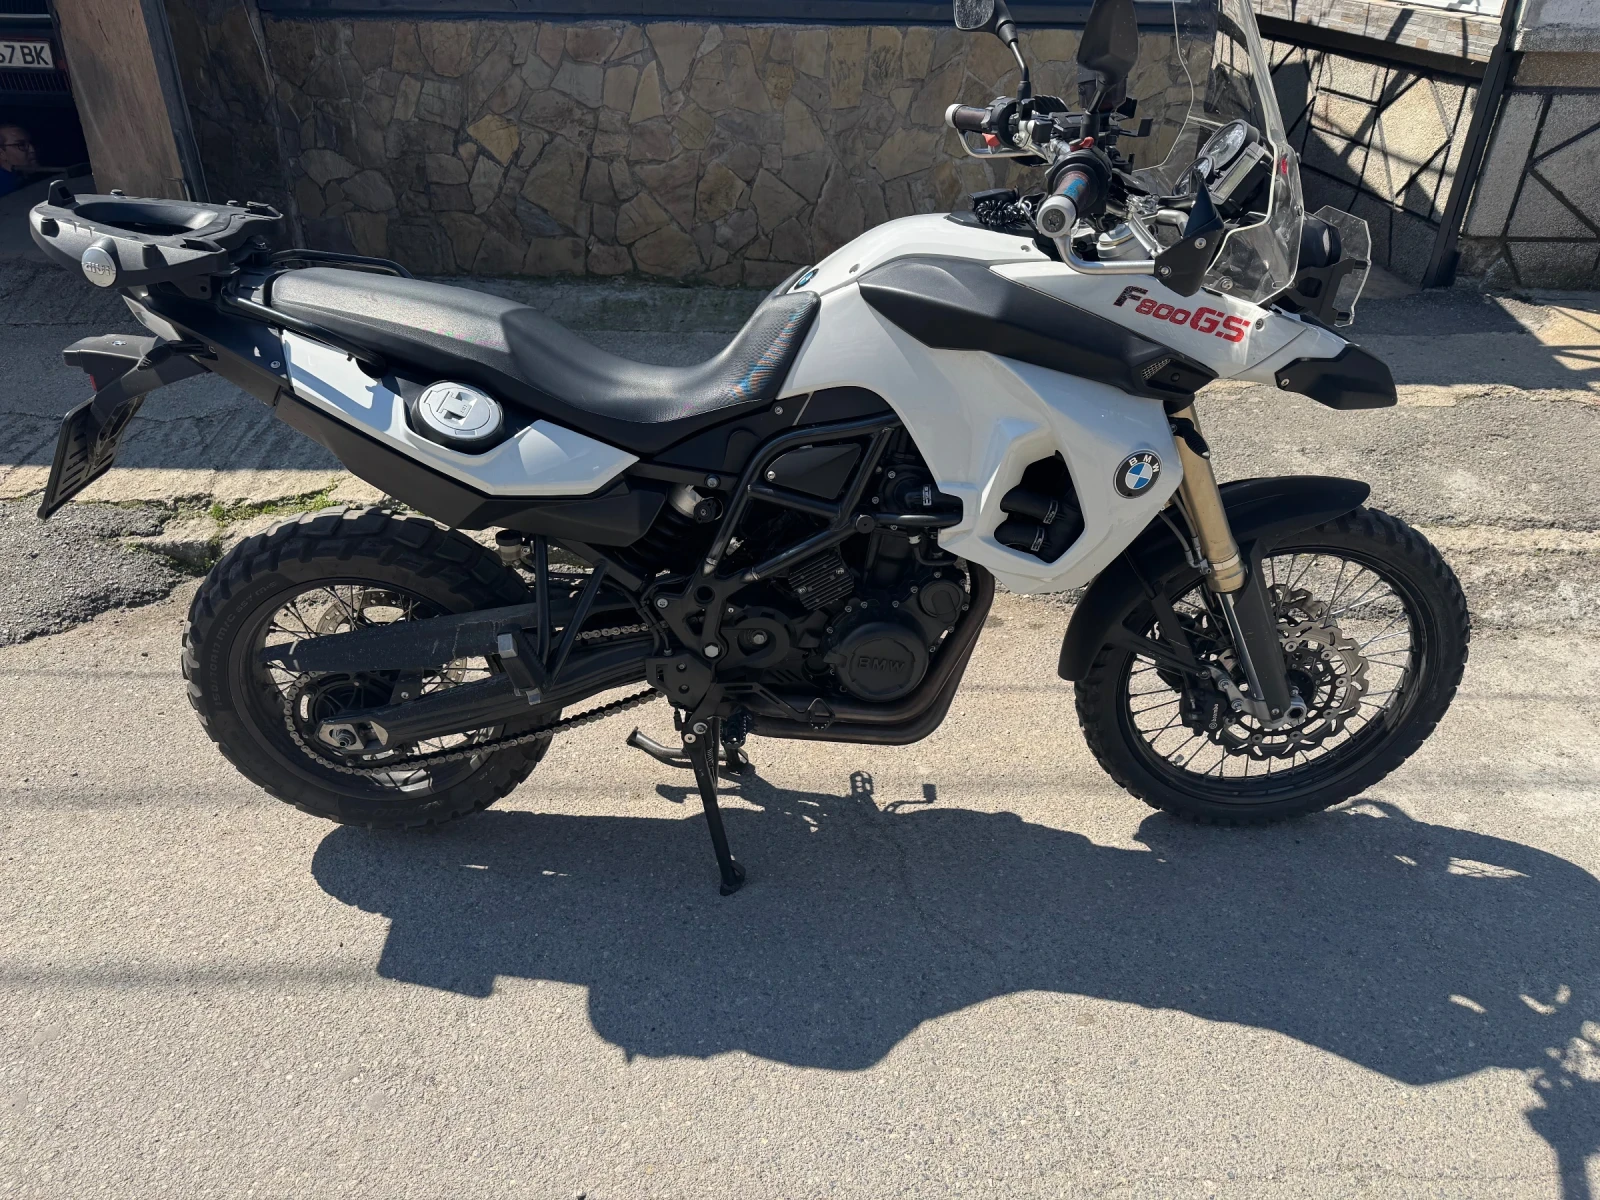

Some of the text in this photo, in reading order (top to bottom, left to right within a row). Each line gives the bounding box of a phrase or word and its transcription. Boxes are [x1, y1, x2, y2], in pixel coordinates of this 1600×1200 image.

[20, 45, 50, 66] BK
[1128, 454, 1160, 473] BMW
[858, 656, 906, 672] BMW
